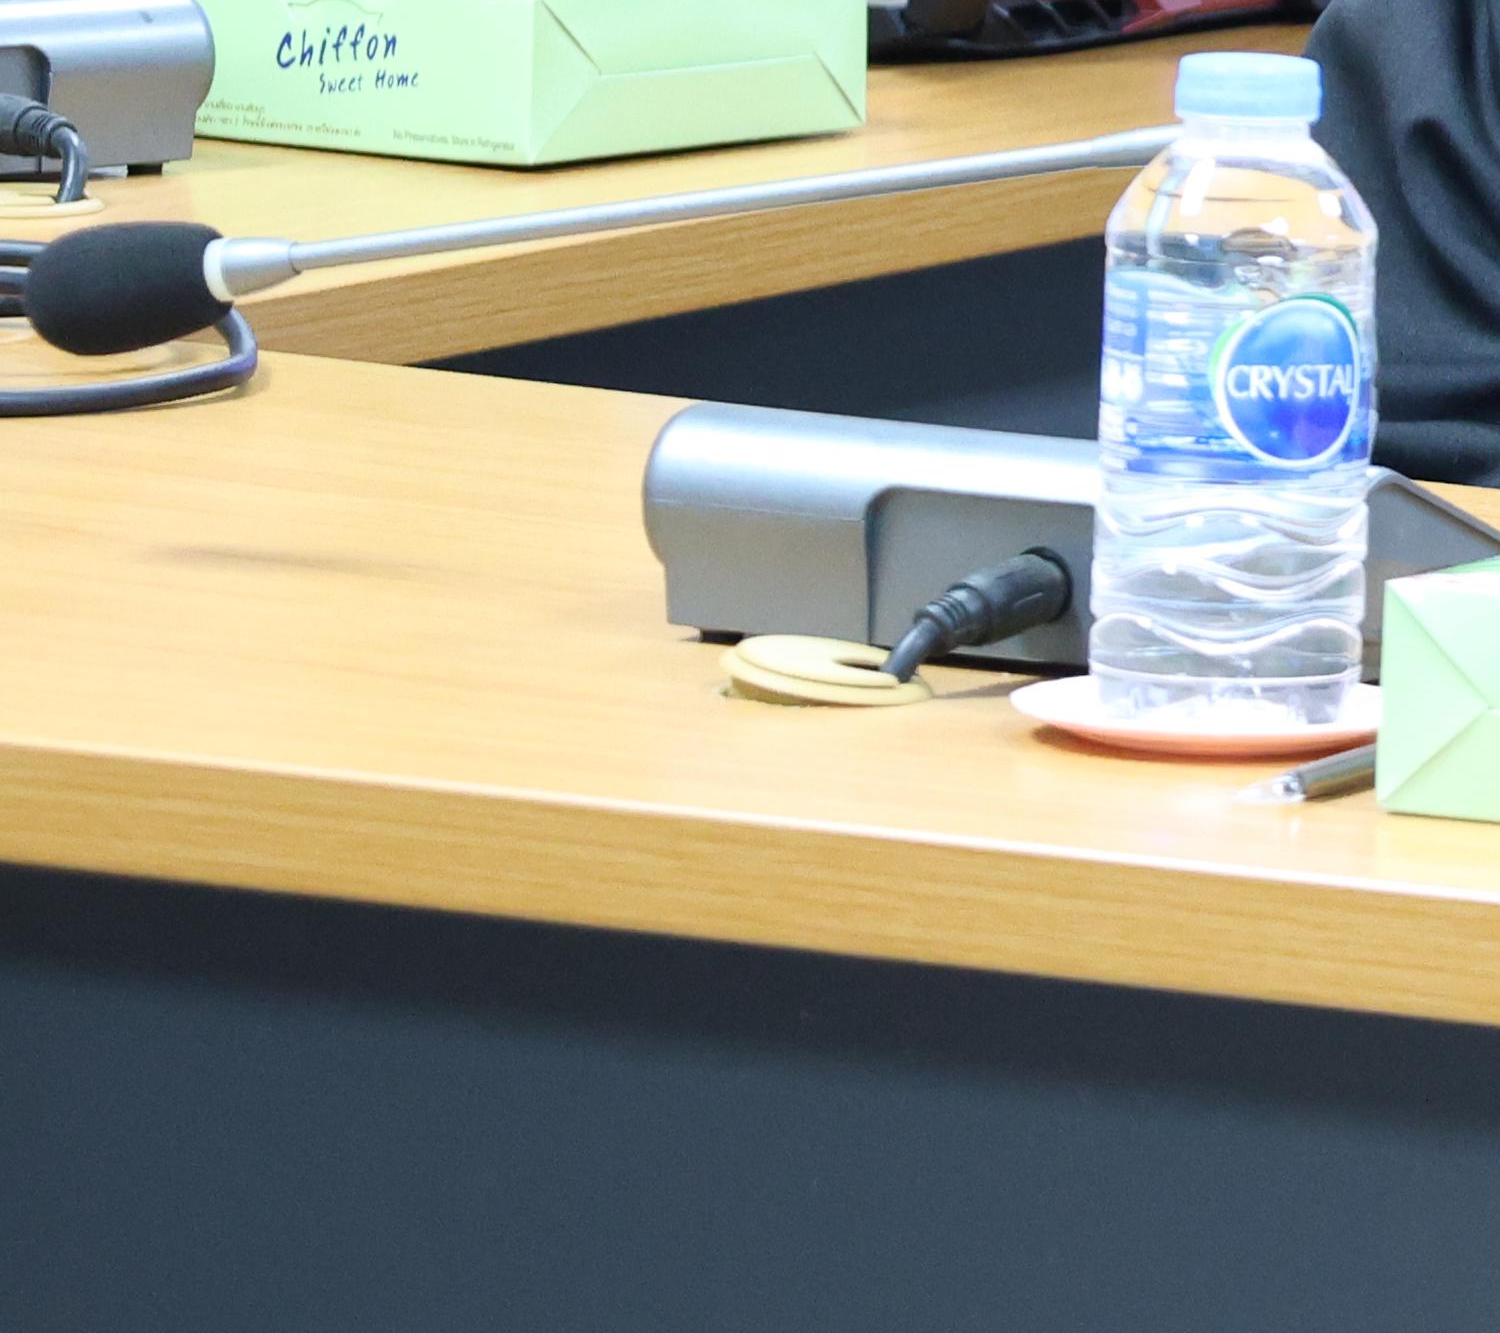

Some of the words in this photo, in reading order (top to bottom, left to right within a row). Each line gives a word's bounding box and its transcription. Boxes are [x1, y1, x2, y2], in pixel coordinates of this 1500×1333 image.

[275, 23, 398, 70] Chiffon
[318, 73, 363, 95] Sweet
[374, 69, 420, 90] Home
[1226, 362, 1354, 402] CRYSTAL
